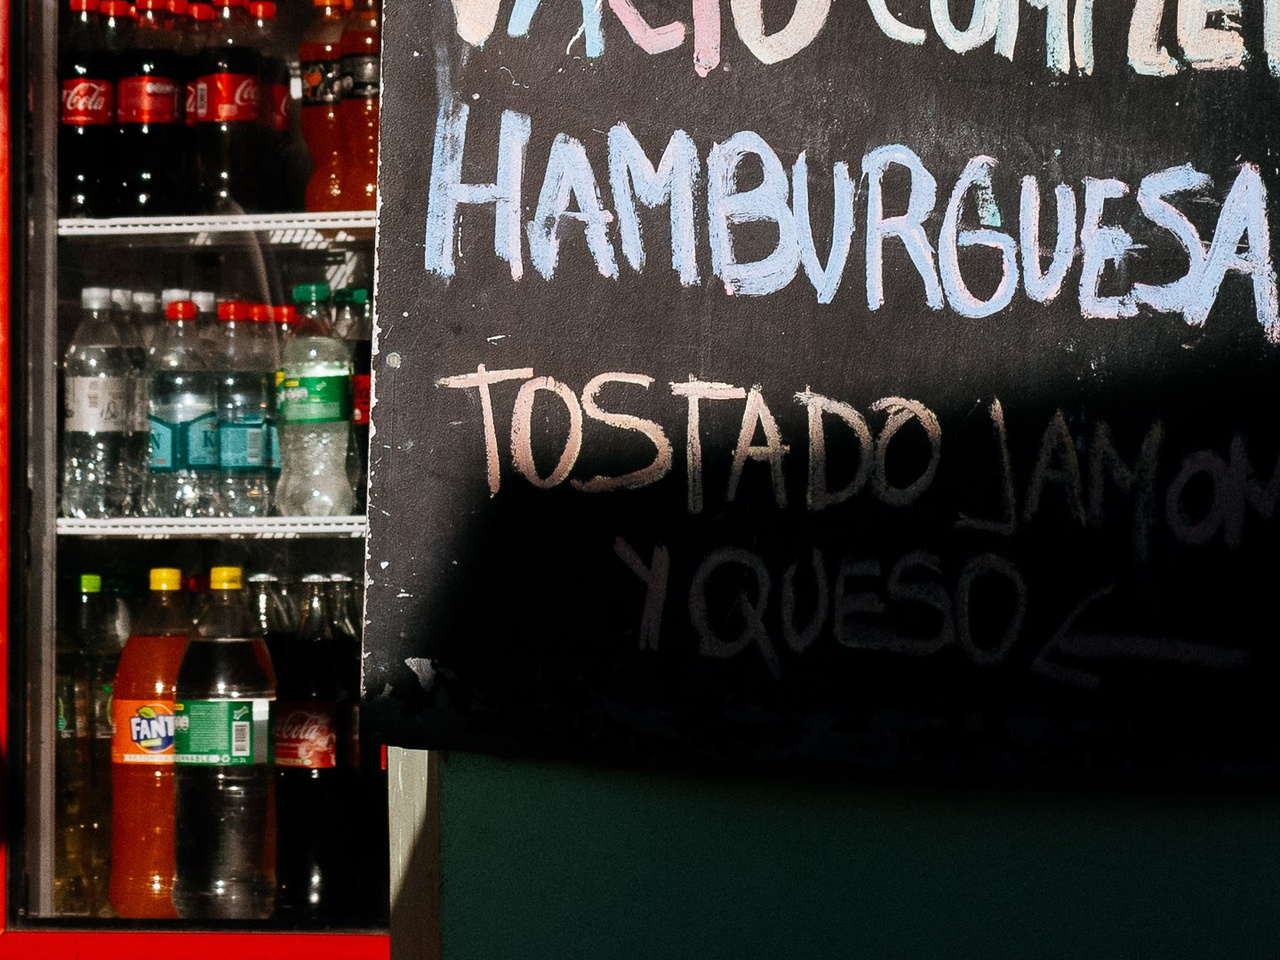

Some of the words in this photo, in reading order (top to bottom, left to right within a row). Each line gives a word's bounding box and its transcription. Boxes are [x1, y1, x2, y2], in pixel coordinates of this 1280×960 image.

[434, 362, 943, 515] TOSTADO
[610, 534, 672, 653] Y
[686, 542, 1030, 683] QUESO
